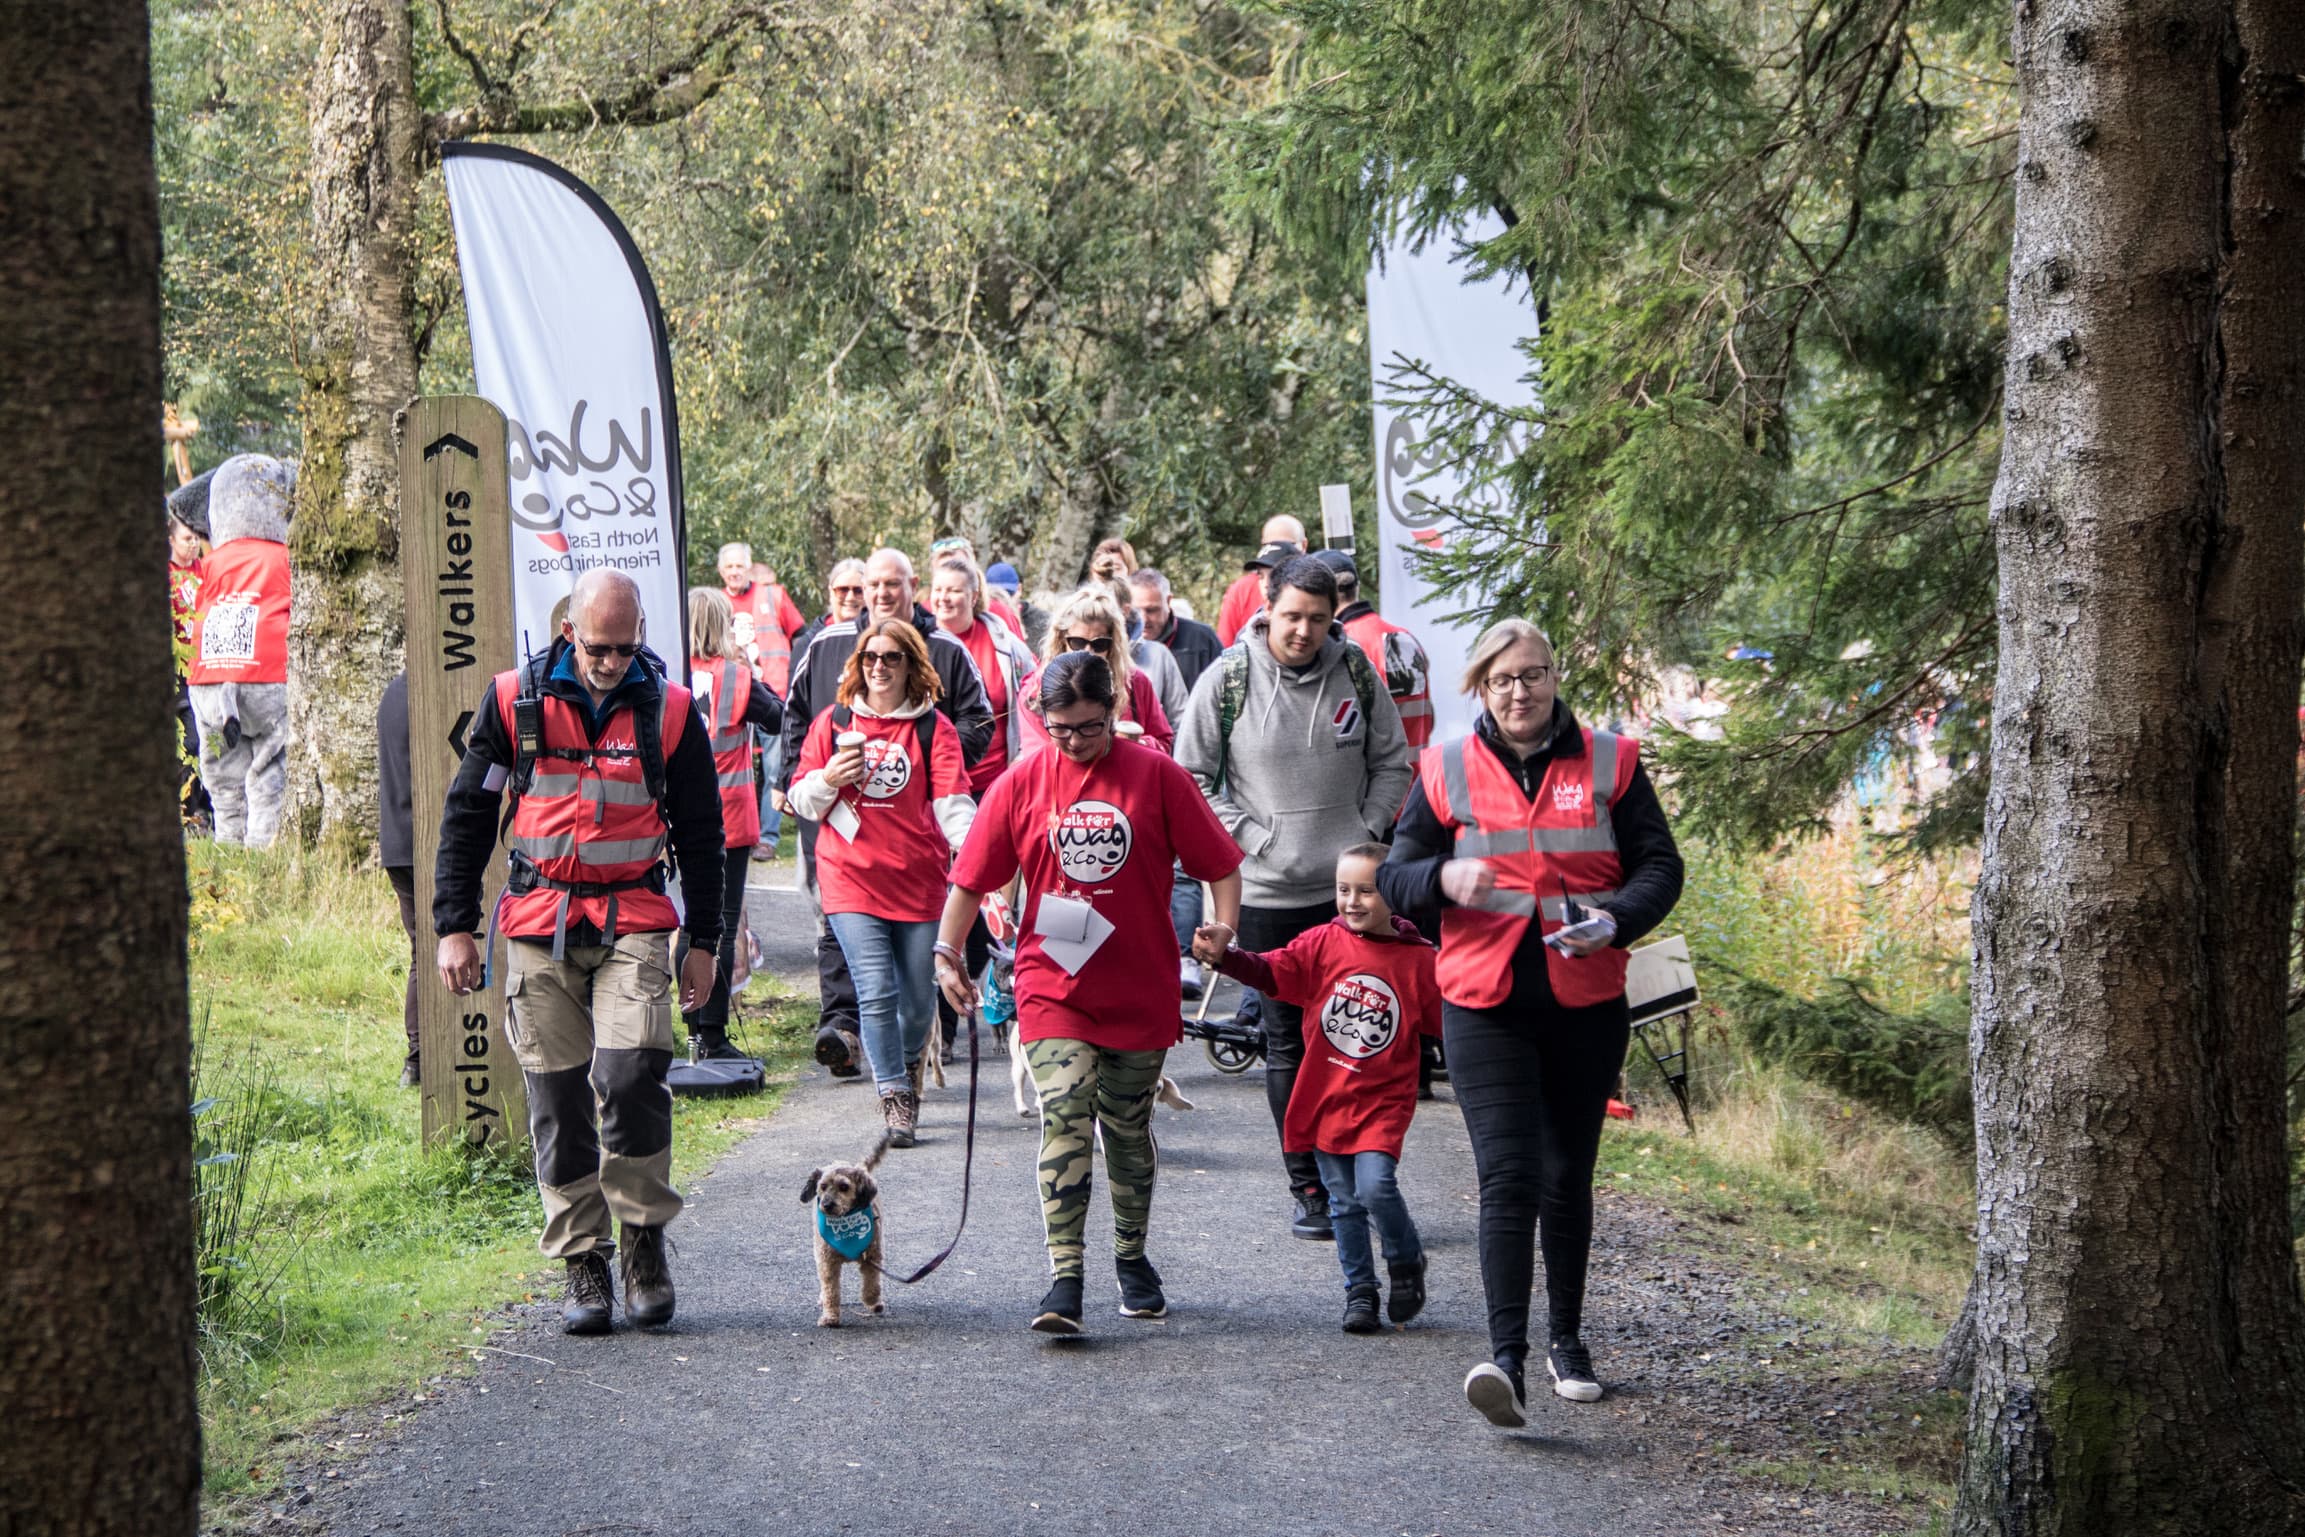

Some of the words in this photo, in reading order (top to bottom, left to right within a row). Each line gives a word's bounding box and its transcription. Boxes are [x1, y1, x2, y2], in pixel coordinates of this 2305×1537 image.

[438, 490, 476, 672] Walkers
[1085, 814, 1113, 828] for
[1334, 981, 1363, 999] Walk
[1363, 991, 1387, 1009] for
